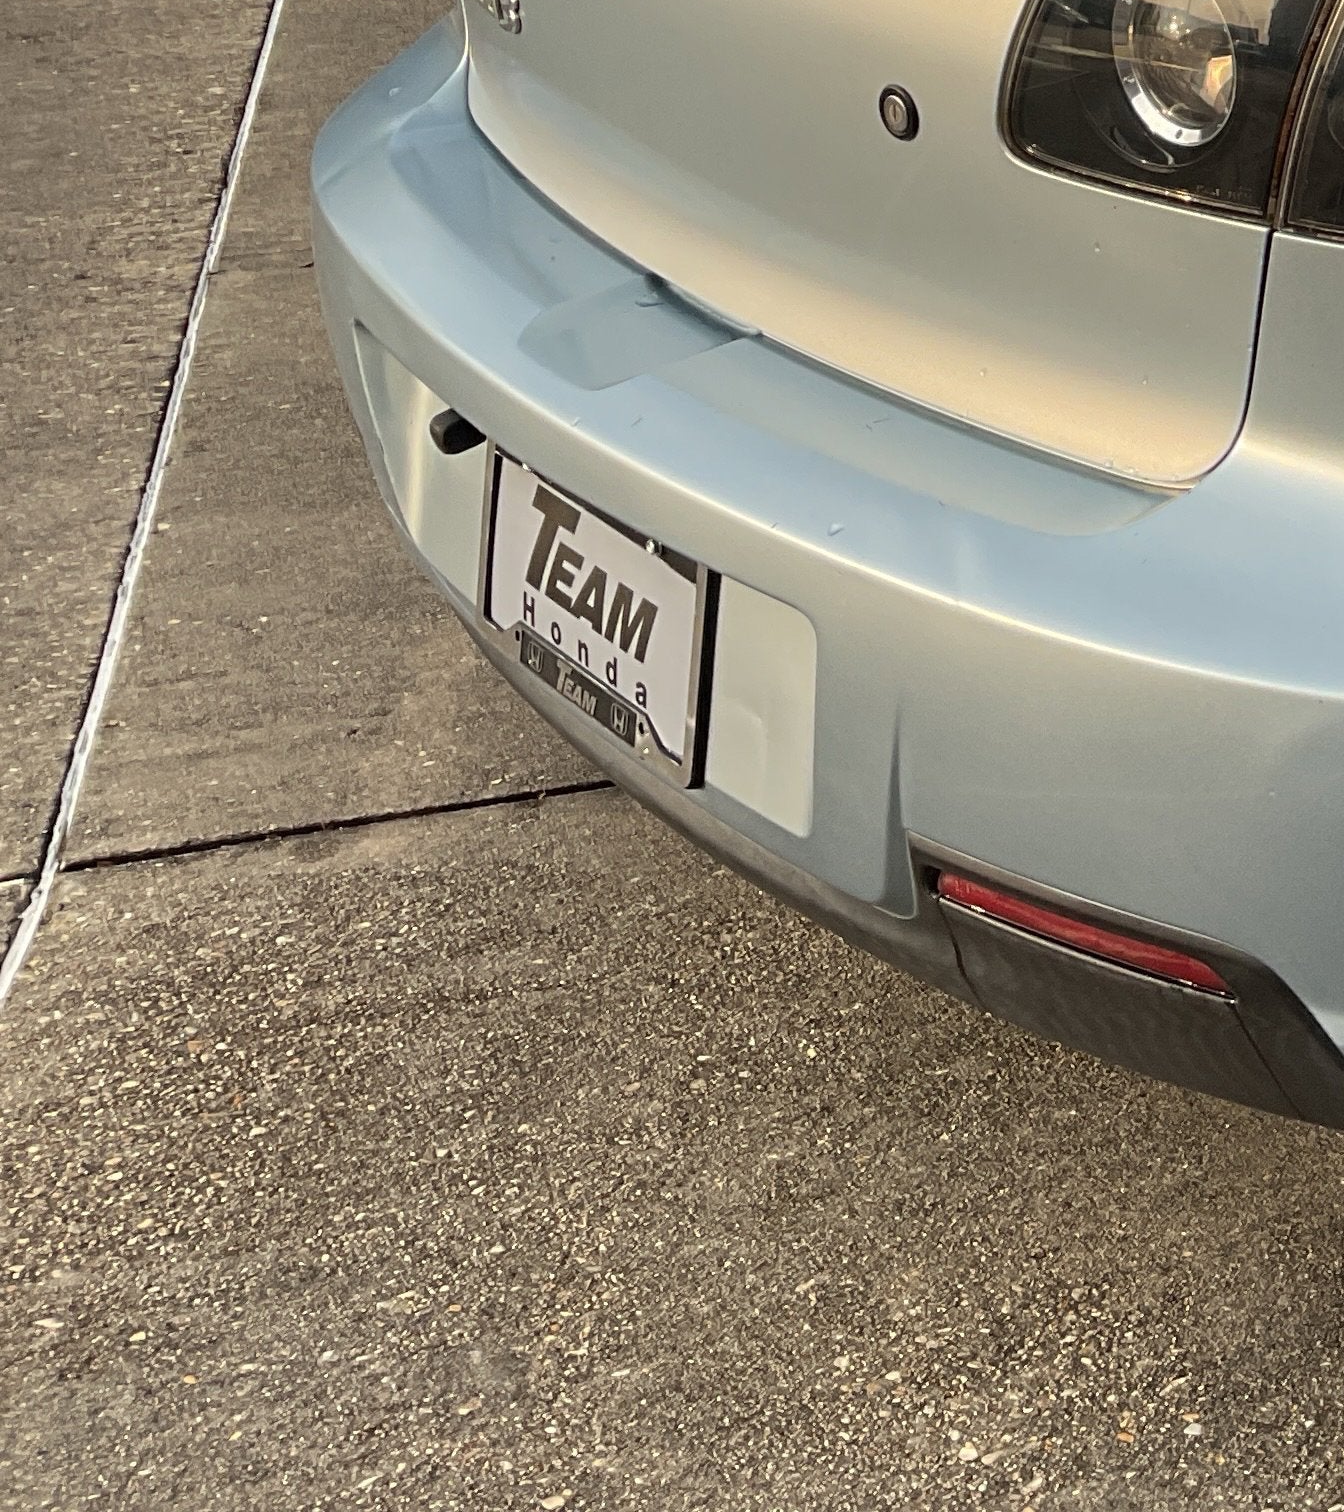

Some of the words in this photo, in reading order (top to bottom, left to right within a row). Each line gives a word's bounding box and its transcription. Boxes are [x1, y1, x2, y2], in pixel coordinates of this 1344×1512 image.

[525, 484, 659, 664] TEAM
[523, 591, 647, 709] Honda
[557, 659, 598, 717] TEAM
